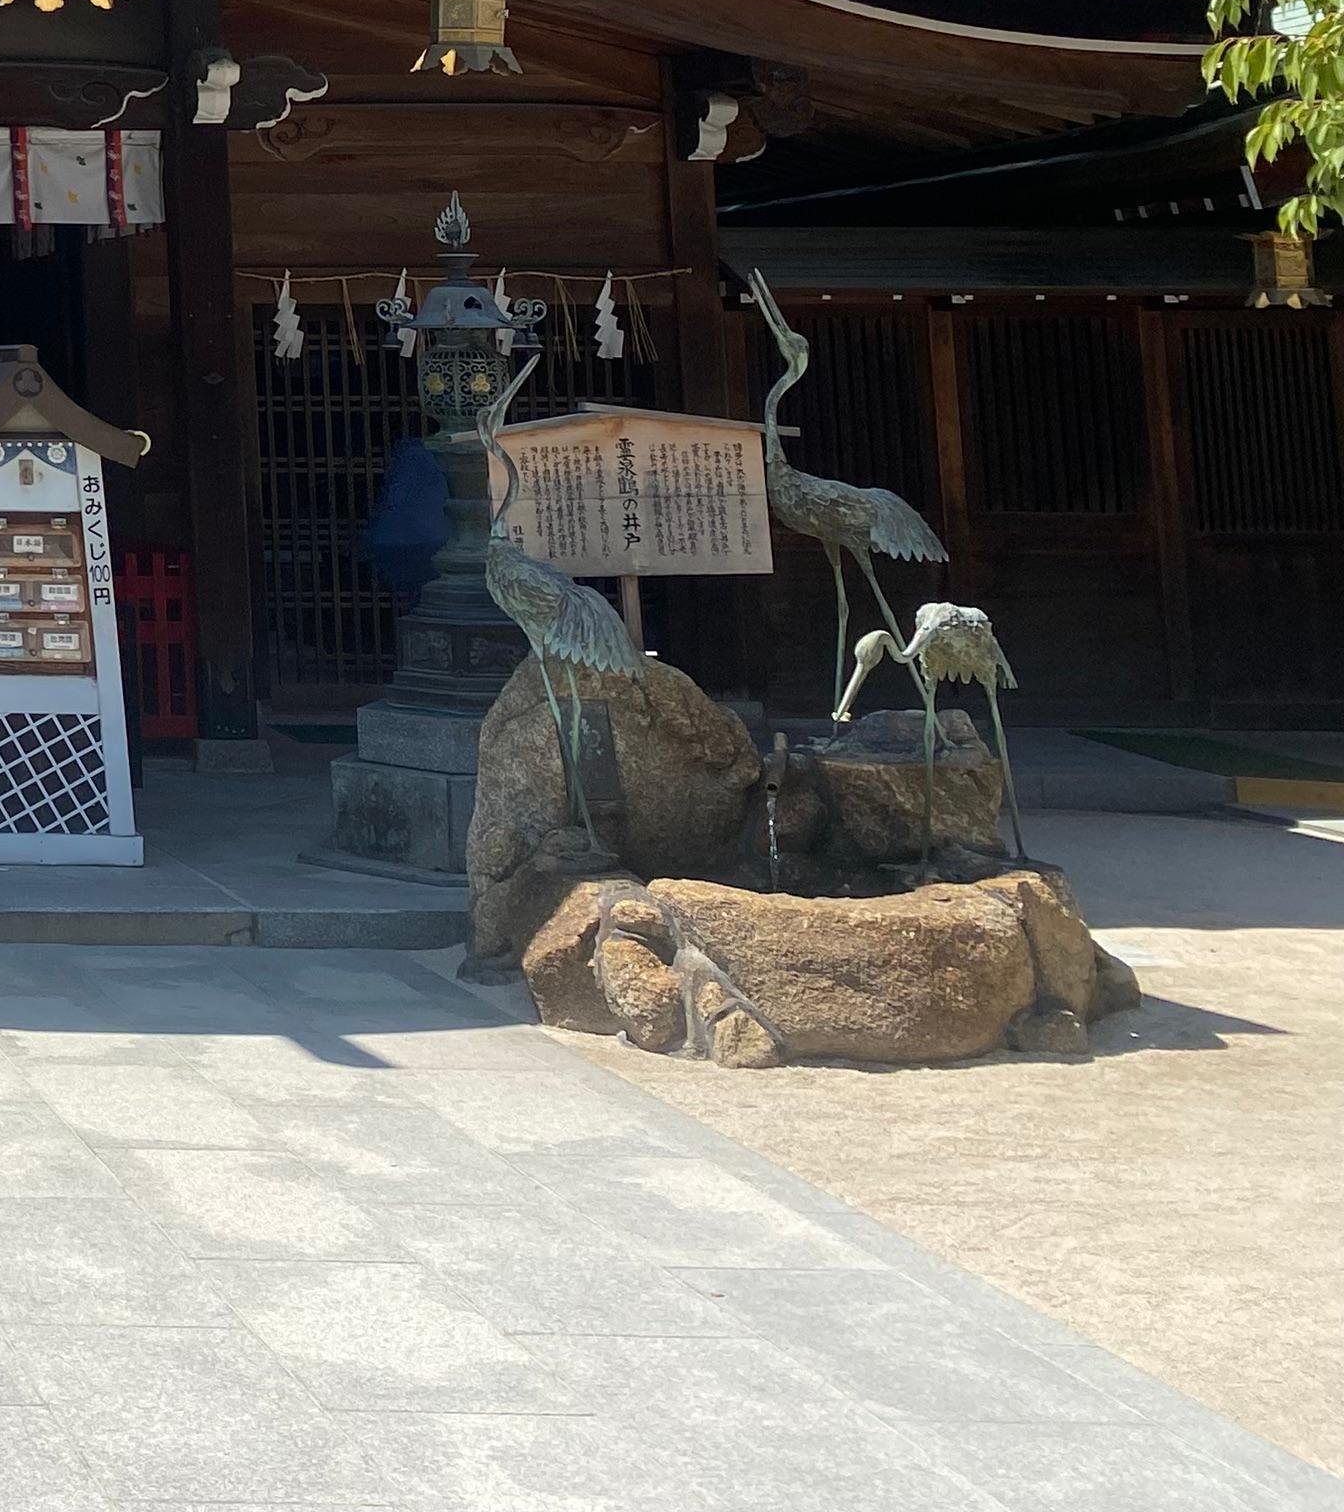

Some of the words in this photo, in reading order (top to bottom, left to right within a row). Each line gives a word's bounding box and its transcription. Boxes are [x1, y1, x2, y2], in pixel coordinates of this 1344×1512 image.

[82, 475, 111, 606] おみくじ100円
